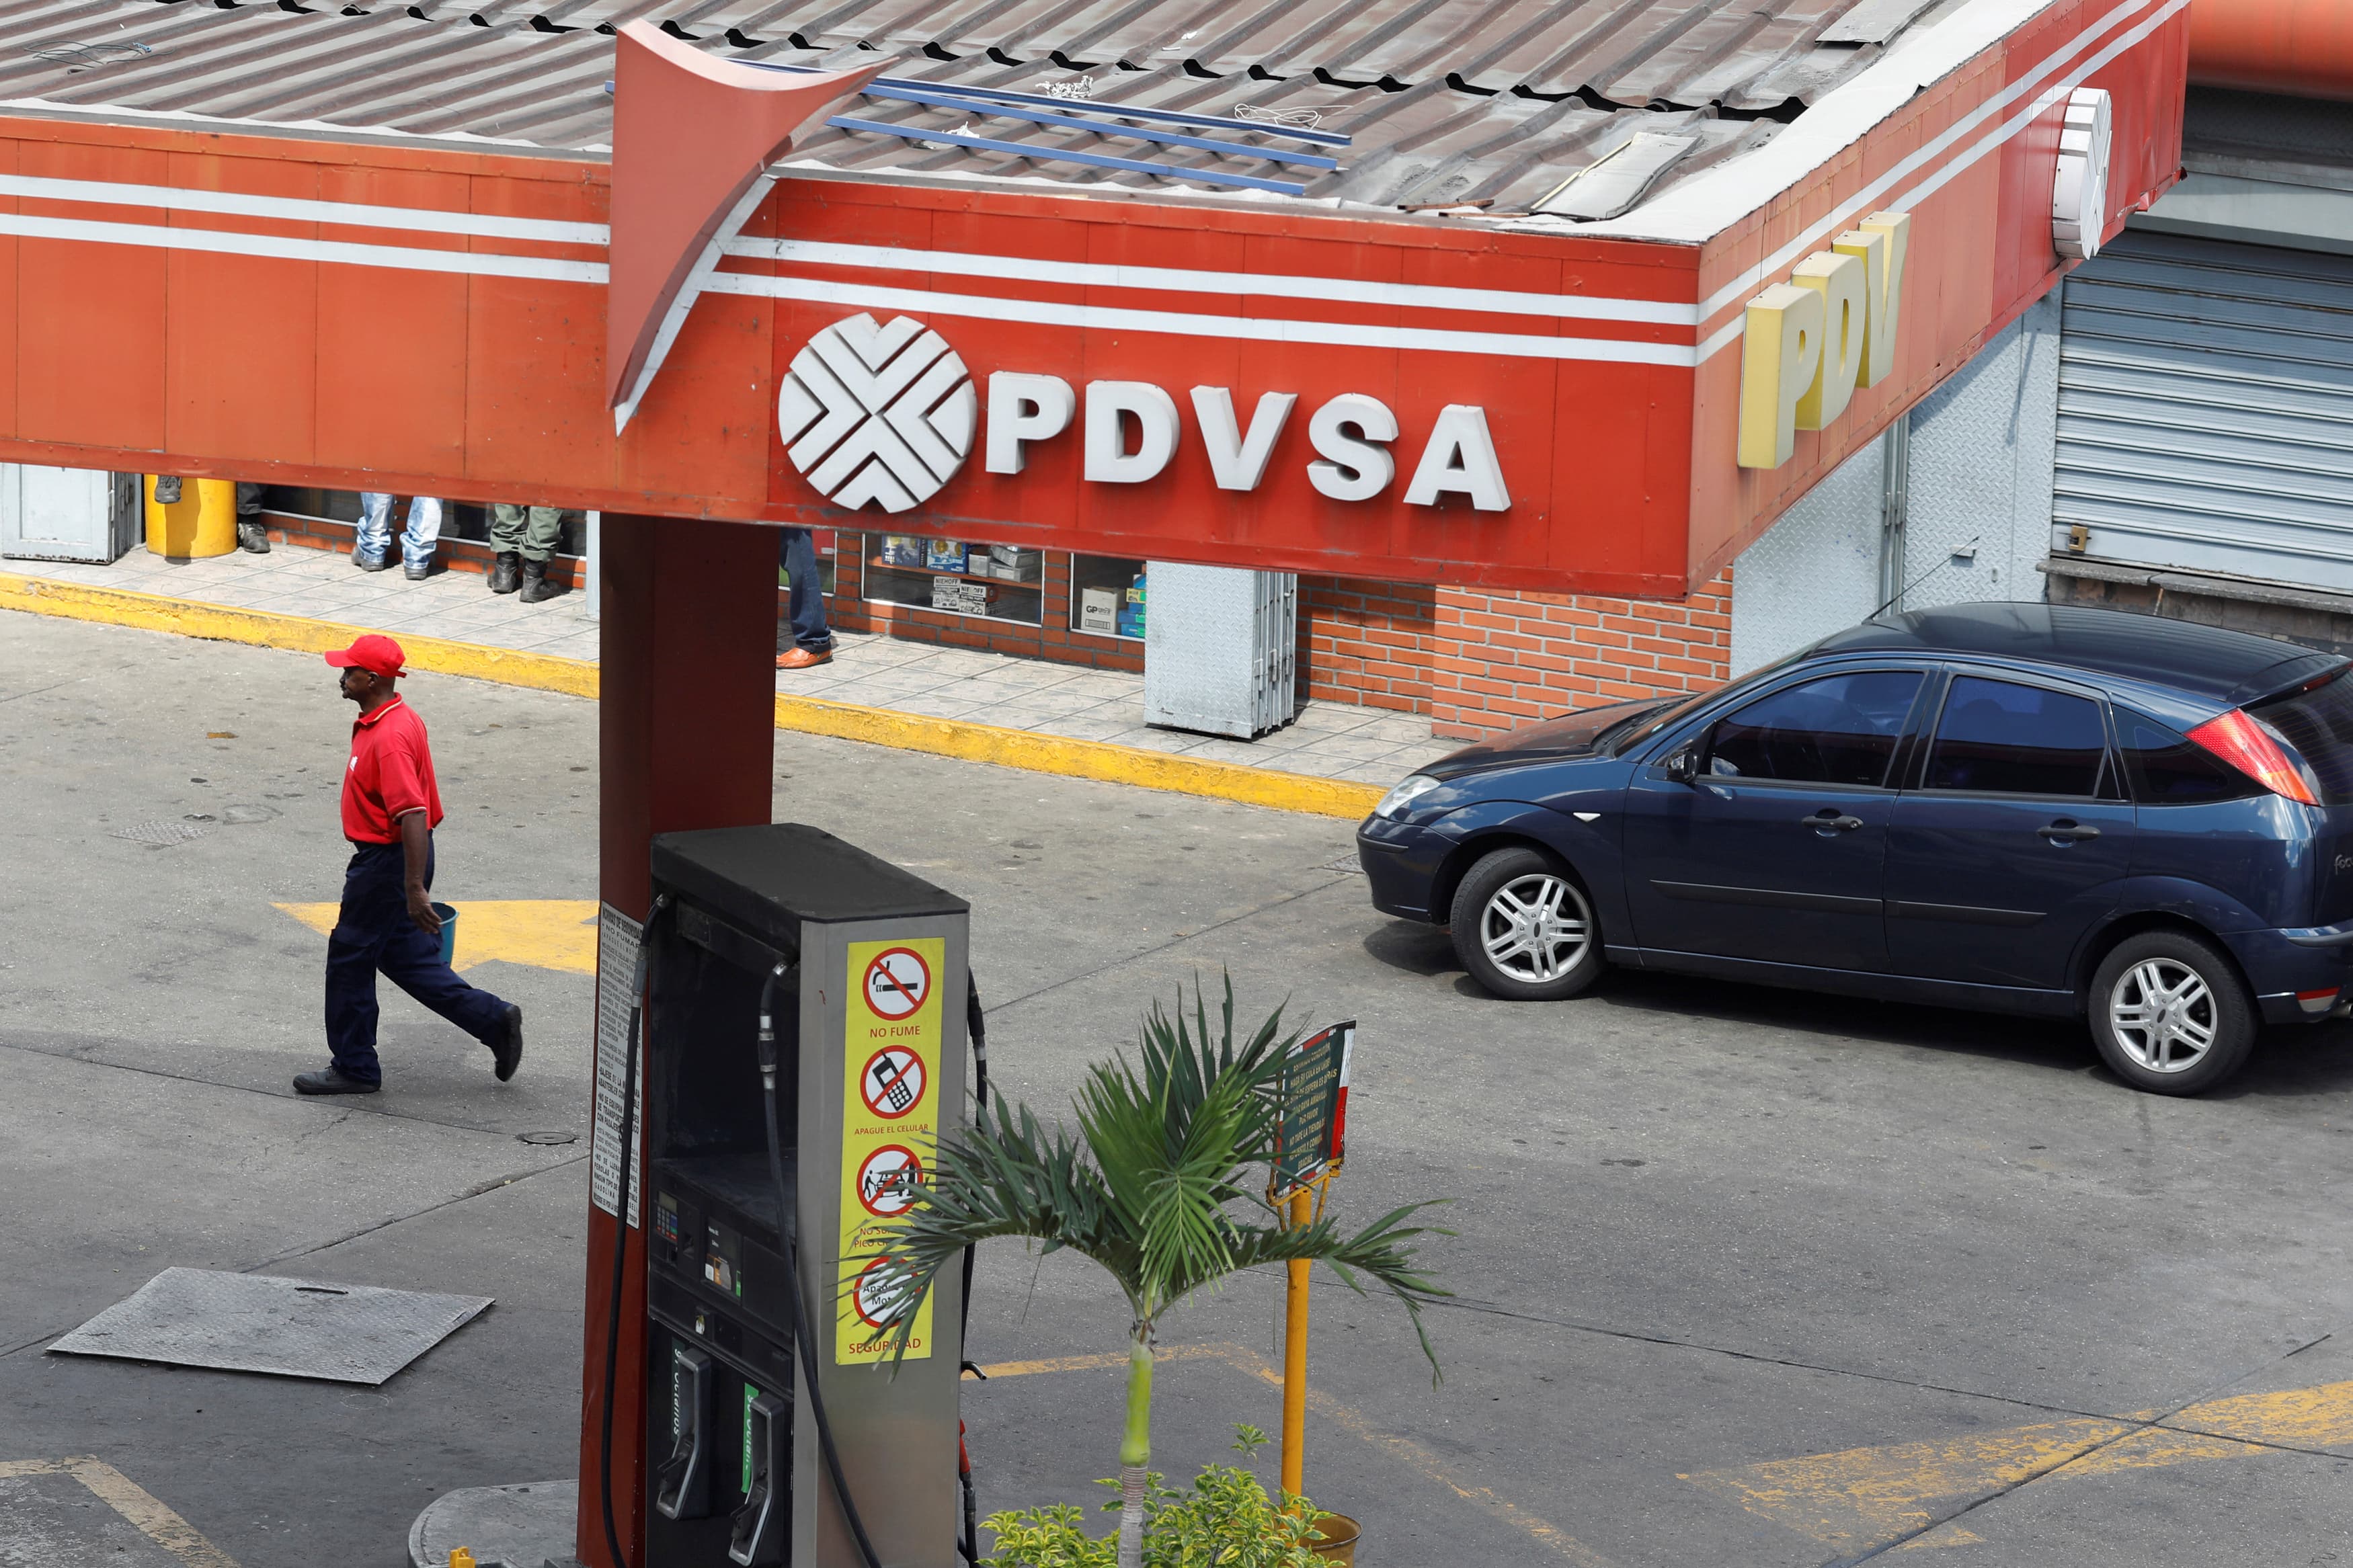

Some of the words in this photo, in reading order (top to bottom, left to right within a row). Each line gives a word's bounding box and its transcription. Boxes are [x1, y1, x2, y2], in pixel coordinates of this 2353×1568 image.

[1737, 210, 1911, 469] PDV
[986, 370, 1511, 512] PDVSA
[961, 585, 984, 594] NIEOFF
[1086, 605, 1098, 614] GP
[606, 924, 615, 936] NO
[870, 1029, 887, 1039] NO
[890, 1026, 921, 1037] FUME
[1306, 1068, 1316, 1083] COLA
[1304, 1080, 1318, 1096] ESPERA
[1306, 1106, 1318, 1123] FAVOR
[854, 1126, 885, 1135] APAGUE
[887, 1125, 895, 1134] EL
[897, 1123, 928, 1132] CELULAR
[1298, 1153, 1313, 1171] GRACIAS
[860, 1227, 873, 1236] NO
[848, 1338, 921, 1354] SEGURIDAD
